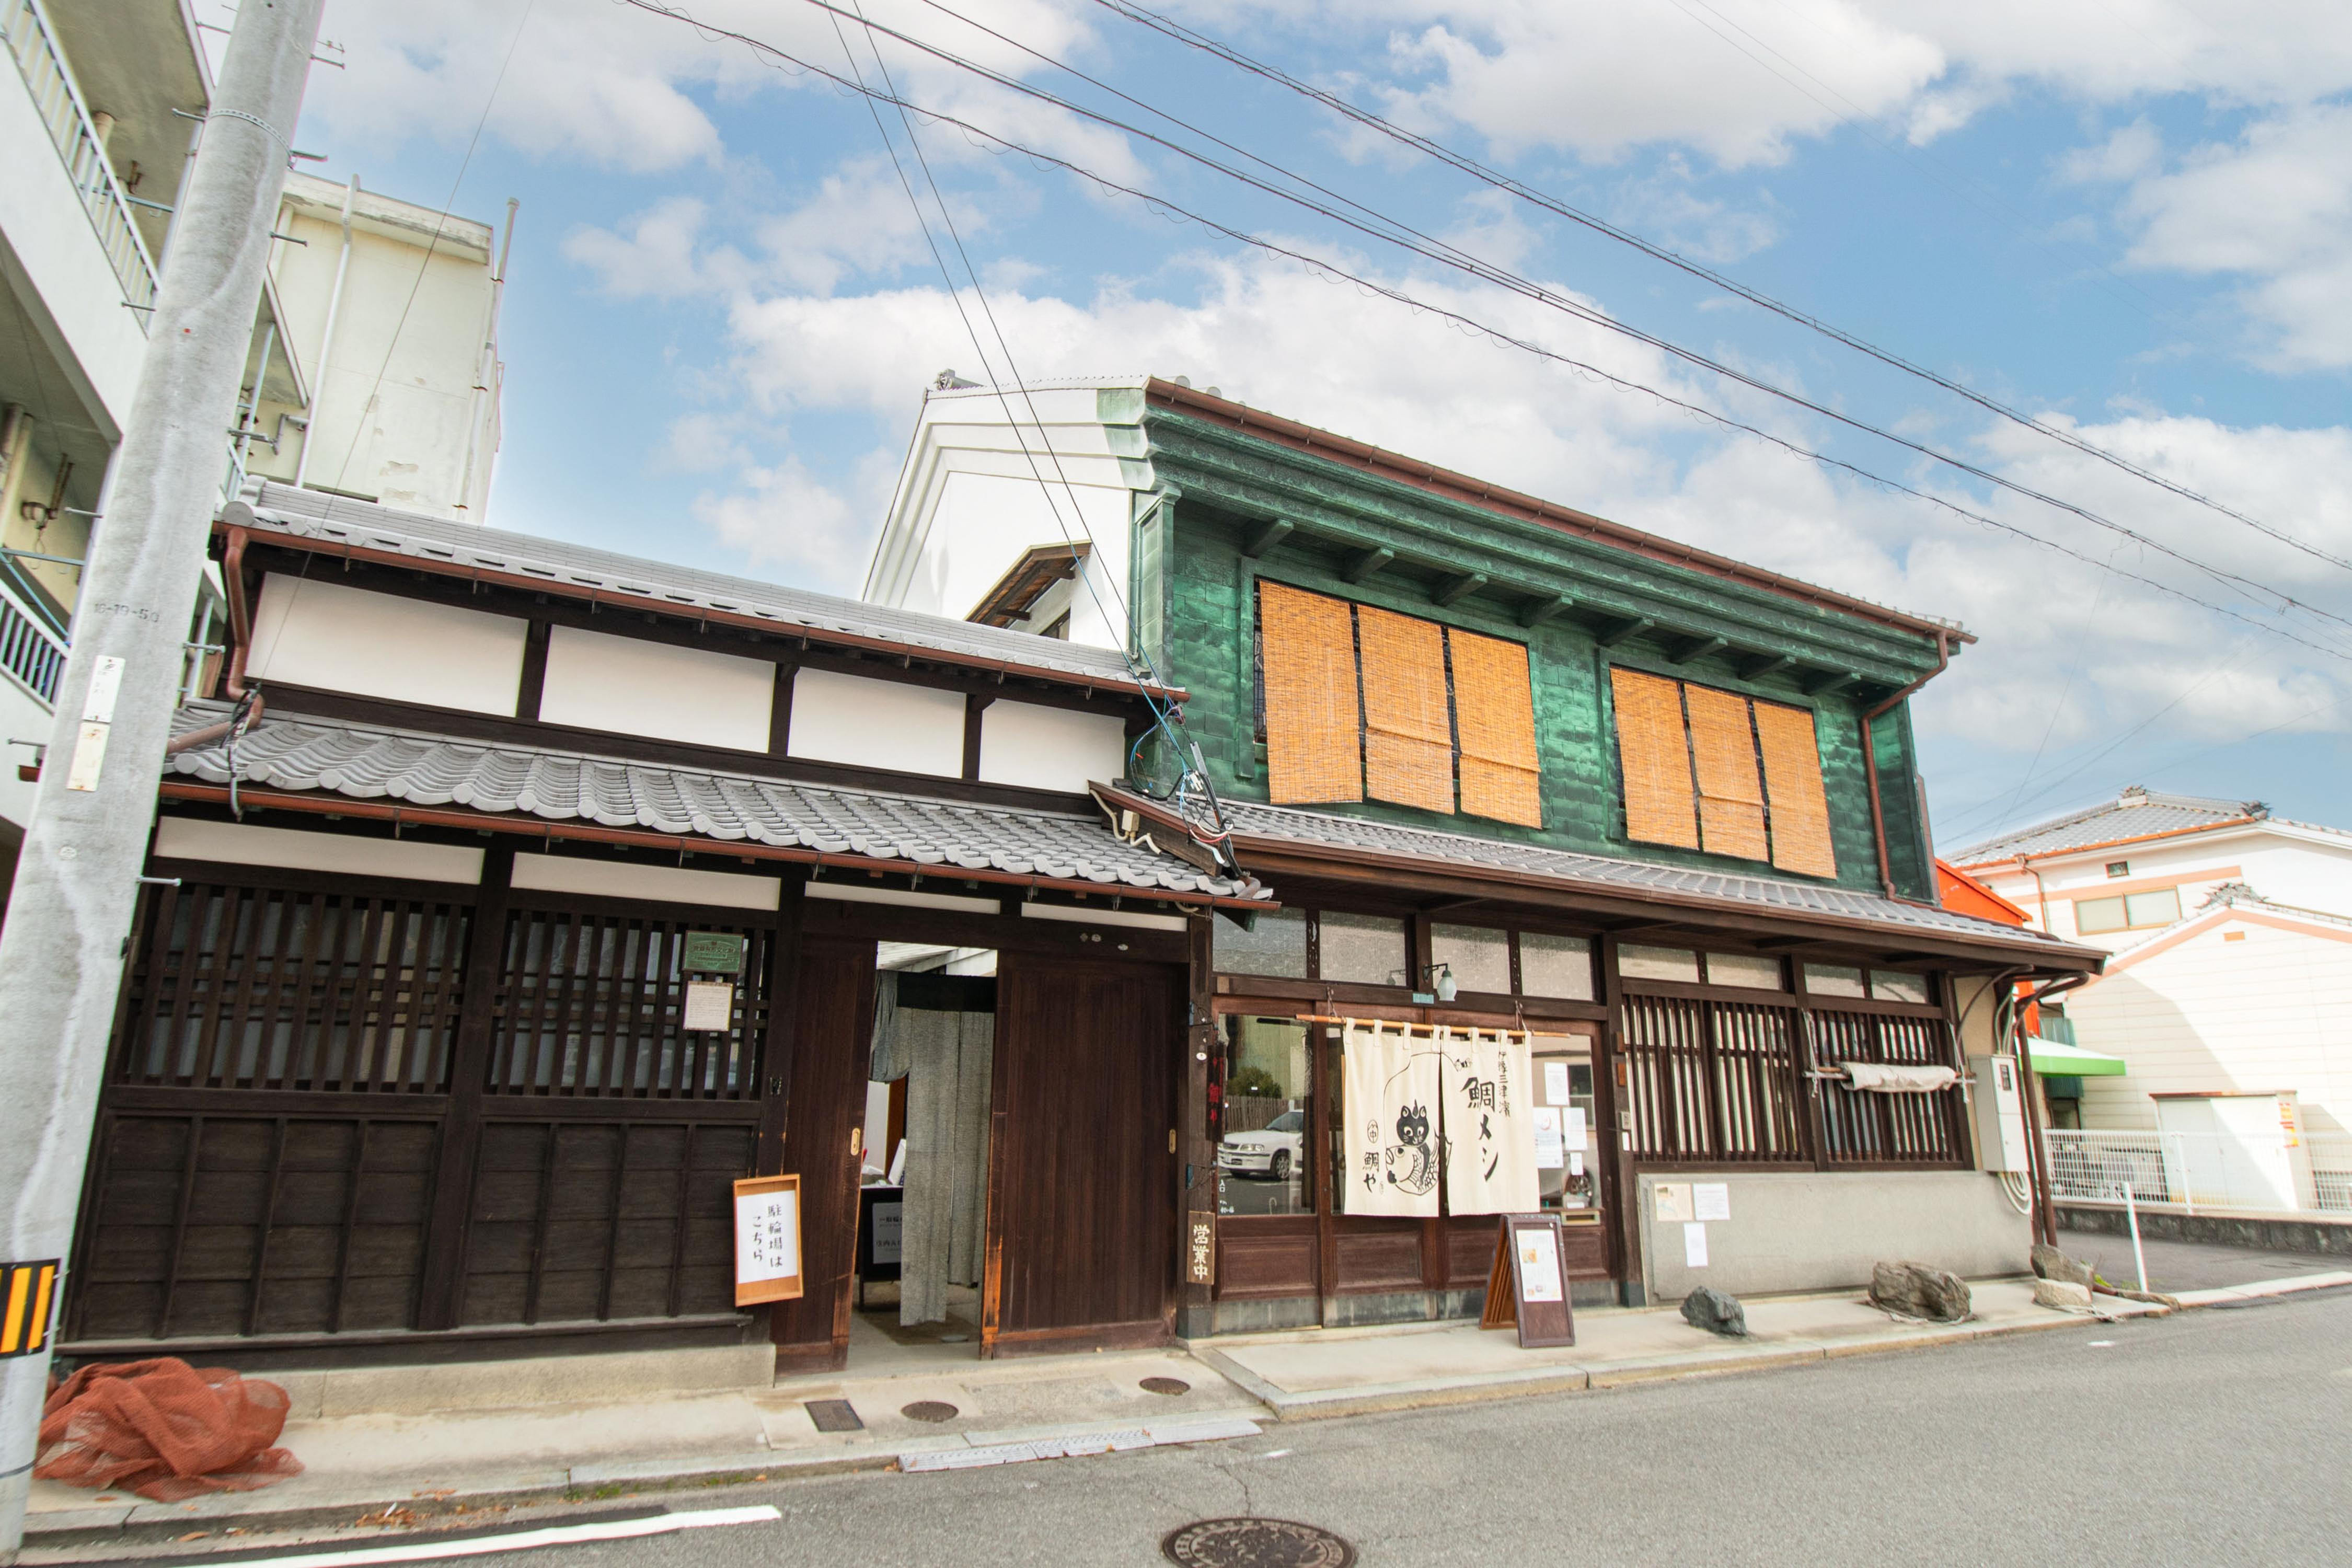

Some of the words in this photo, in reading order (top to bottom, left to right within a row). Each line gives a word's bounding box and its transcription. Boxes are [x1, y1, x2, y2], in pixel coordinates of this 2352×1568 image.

[1460, 1077, 1498, 1182] 鯛メシ
[1362, 1151, 1379, 1193] 鯛や
[752, 1216, 763, 1262] こちら
[767, 1204, 783, 1267] 駐輪場は
[1192, 1225, 1210, 1280] 営業中
